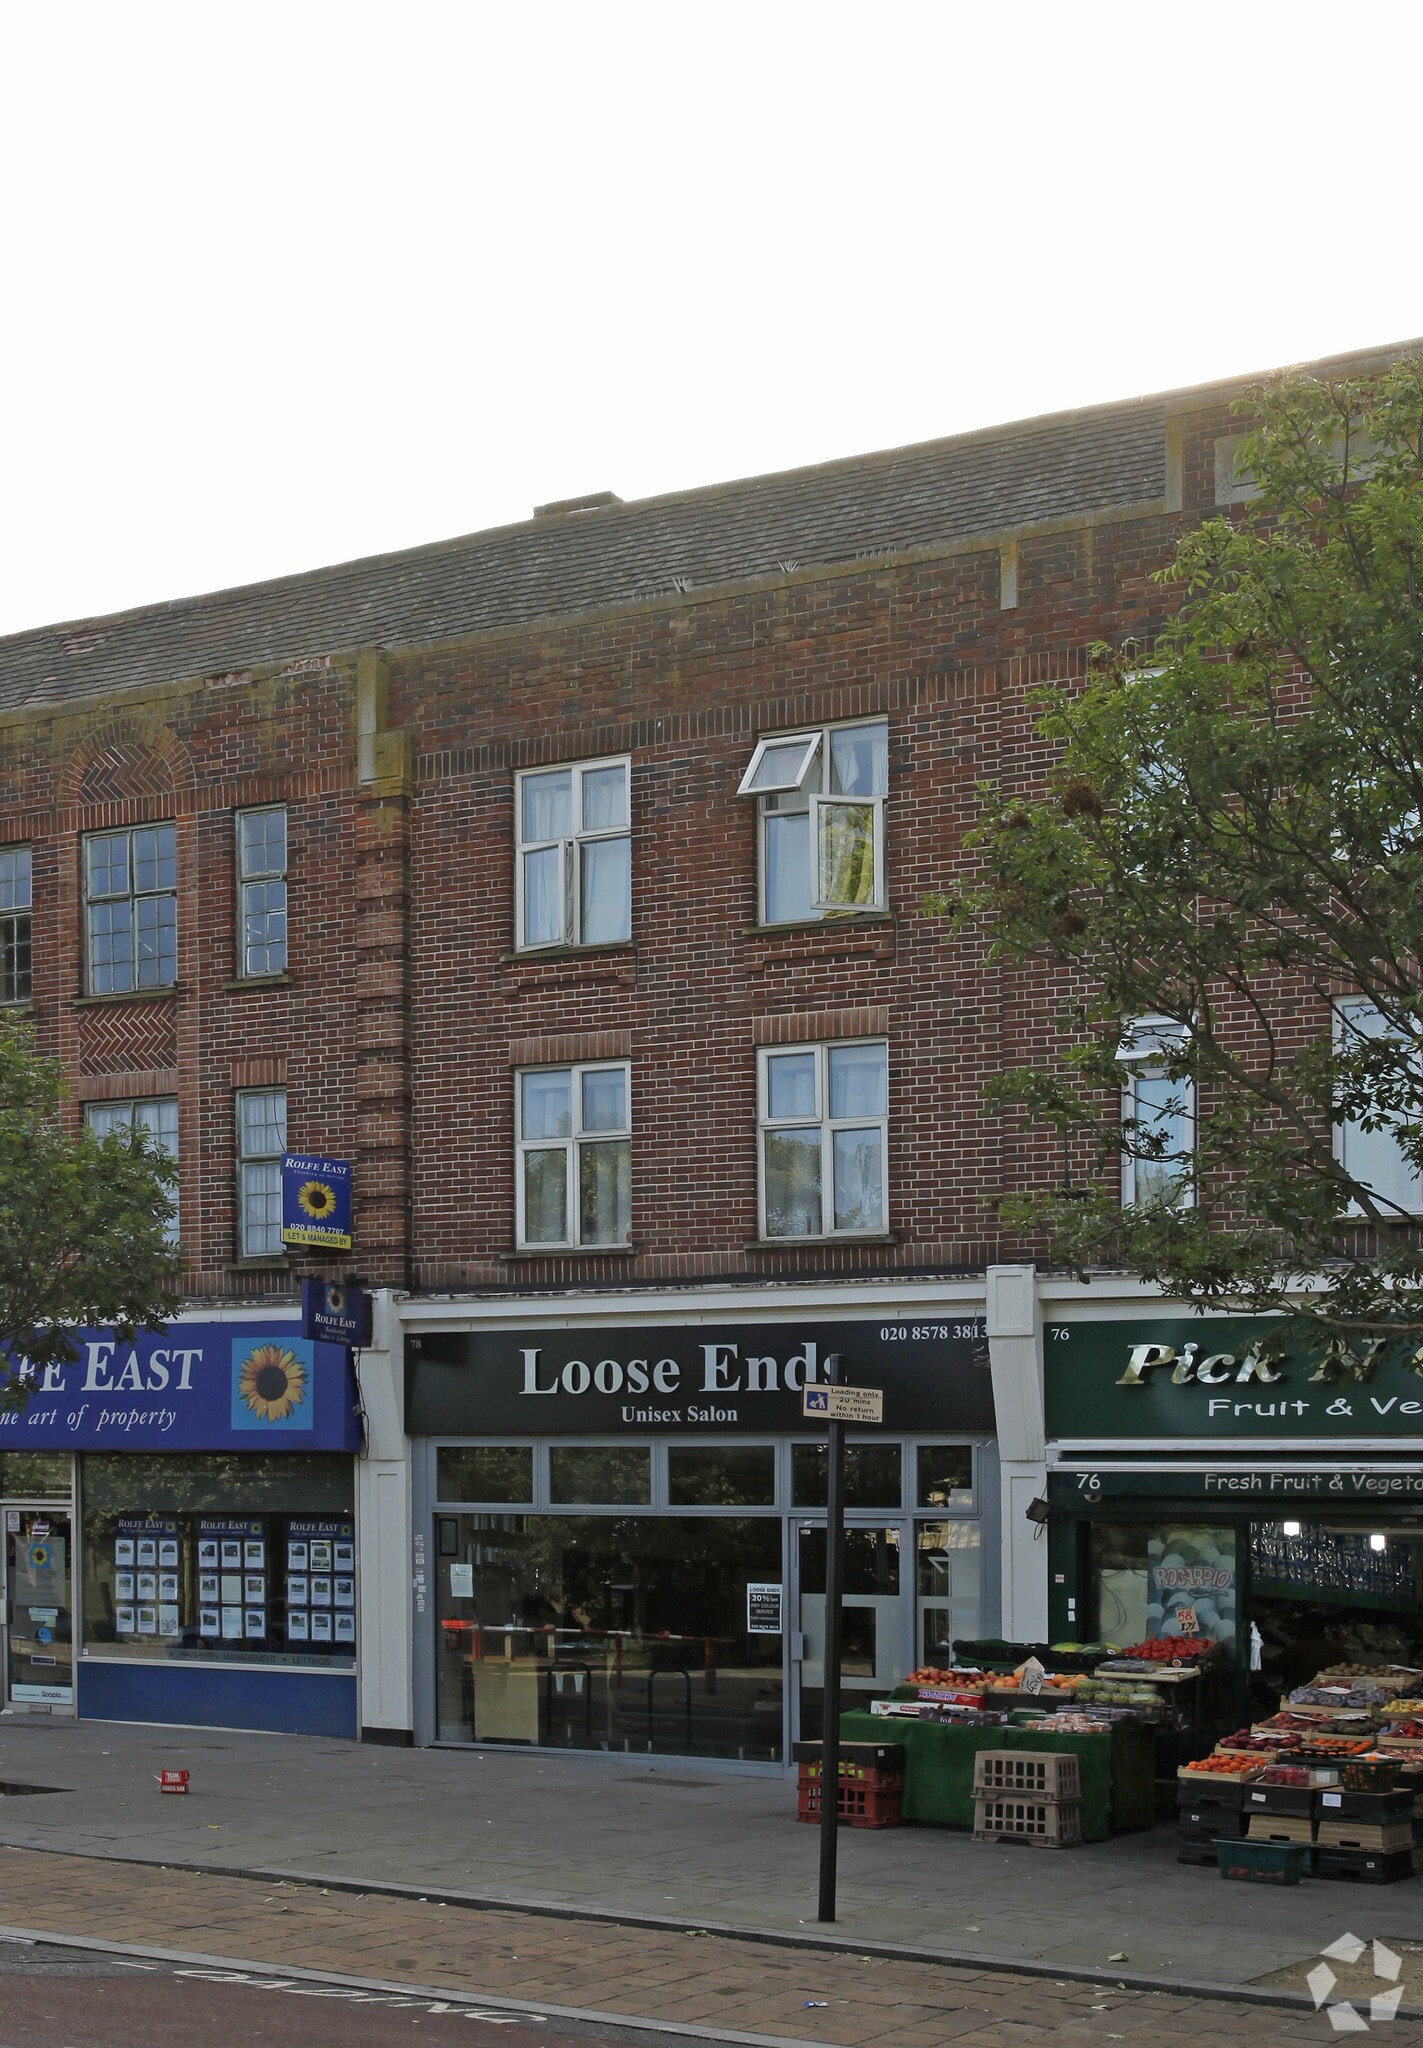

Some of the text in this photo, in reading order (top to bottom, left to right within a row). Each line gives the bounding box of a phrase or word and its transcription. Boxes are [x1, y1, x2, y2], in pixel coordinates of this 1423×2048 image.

[285, 1158, 348, 1174] ROLFE EAST
[290, 1223, 304, 1231] 020
[288, 1232, 300, 1240] LET
[308, 1234, 338, 1244] MANAGED
[340, 1238, 347, 1246] BY
[315, 1312, 356, 1328] ROLFE EAST
[880, 1324, 988, 1340] 020 8578 3813
[1051, 1328, 1070, 1341] 76
[410, 1340, 422, 1349] 78
[80, 1342, 203, 1392] EAST
[518, 1348, 680, 1394] Loose
[1114, 1342, 1286, 1385] Pick
[832, 1388, 860, 1397] Loading
[621, 1406, 738, 1423] Unisex Salon
[1208, 1396, 1423, 1417] Fruit & Ve
[28, 1408, 57, 1425] art
[67, 1404, 89, 1431] of
[95, 1408, 176, 1432] property
[1076, 1474, 1100, 1490] 76
[1205, 1474, 1262, 1491] Fresh
[1270, 1474, 1322, 1490] Fruit
[1328, 1474, 1344, 1490] &
[118, 1519, 164, 1528] ROLFE EAST
[200, 1520, 248, 1530] ROLFE EAST
[290, 1522, 338, 1532] ROLFE EAST
[180, 1652, 219, 1660] PROPERTY
[223, 1653, 276, 1663] MANAGEMENT
[292, 1656, 331, 1665] LETTINGS
